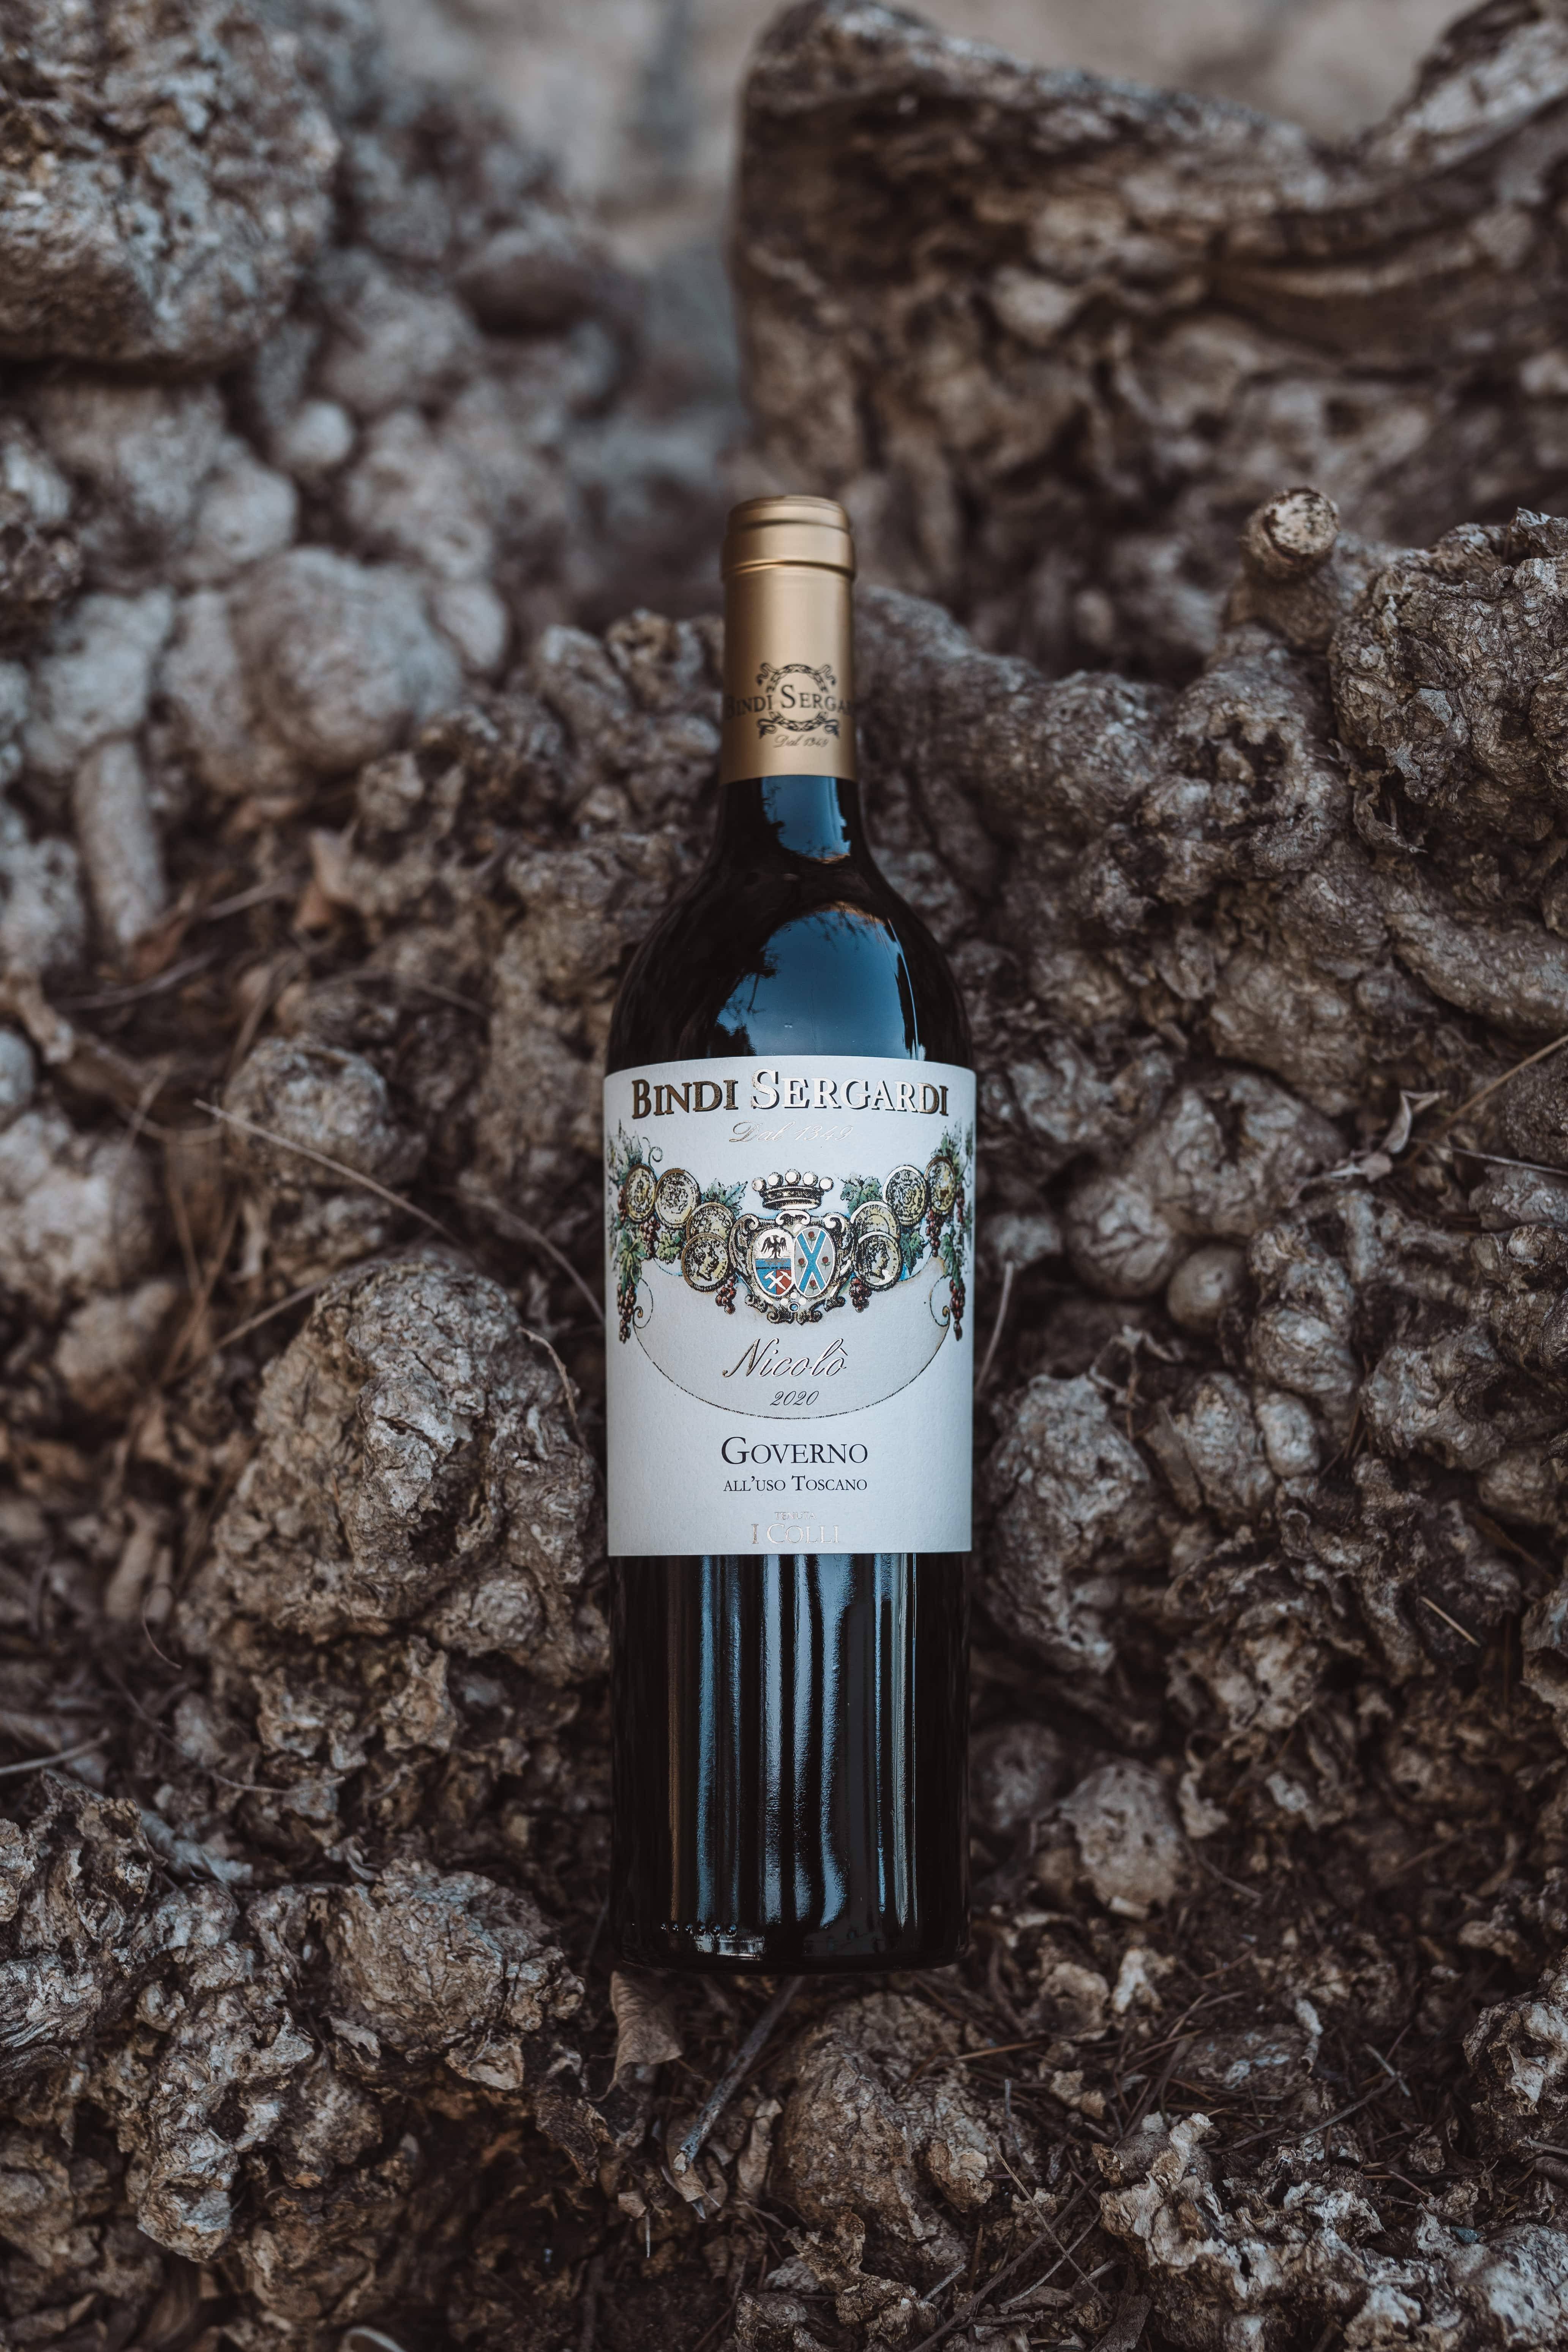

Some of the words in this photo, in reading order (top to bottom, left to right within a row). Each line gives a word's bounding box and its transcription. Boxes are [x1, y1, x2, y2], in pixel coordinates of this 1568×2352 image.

[632, 1079, 739, 1120] BINDI
[751, 1068, 949, 1116] SERGARDI
[728, 1120, 796, 1143] Dal
[793, 1125, 854, 1142] 1349
[722, 1338, 848, 1377] Nicolò
[770, 1391, 820, 1406] 2020
[721, 1436, 868, 1464] GOVERNO
[791, 1475, 868, 1491] TOSCANO
[774, 1511, 817, 1520] TENUTA
[751, 1523, 760, 1545] I
[766, 1523, 840, 1545] COLLI
